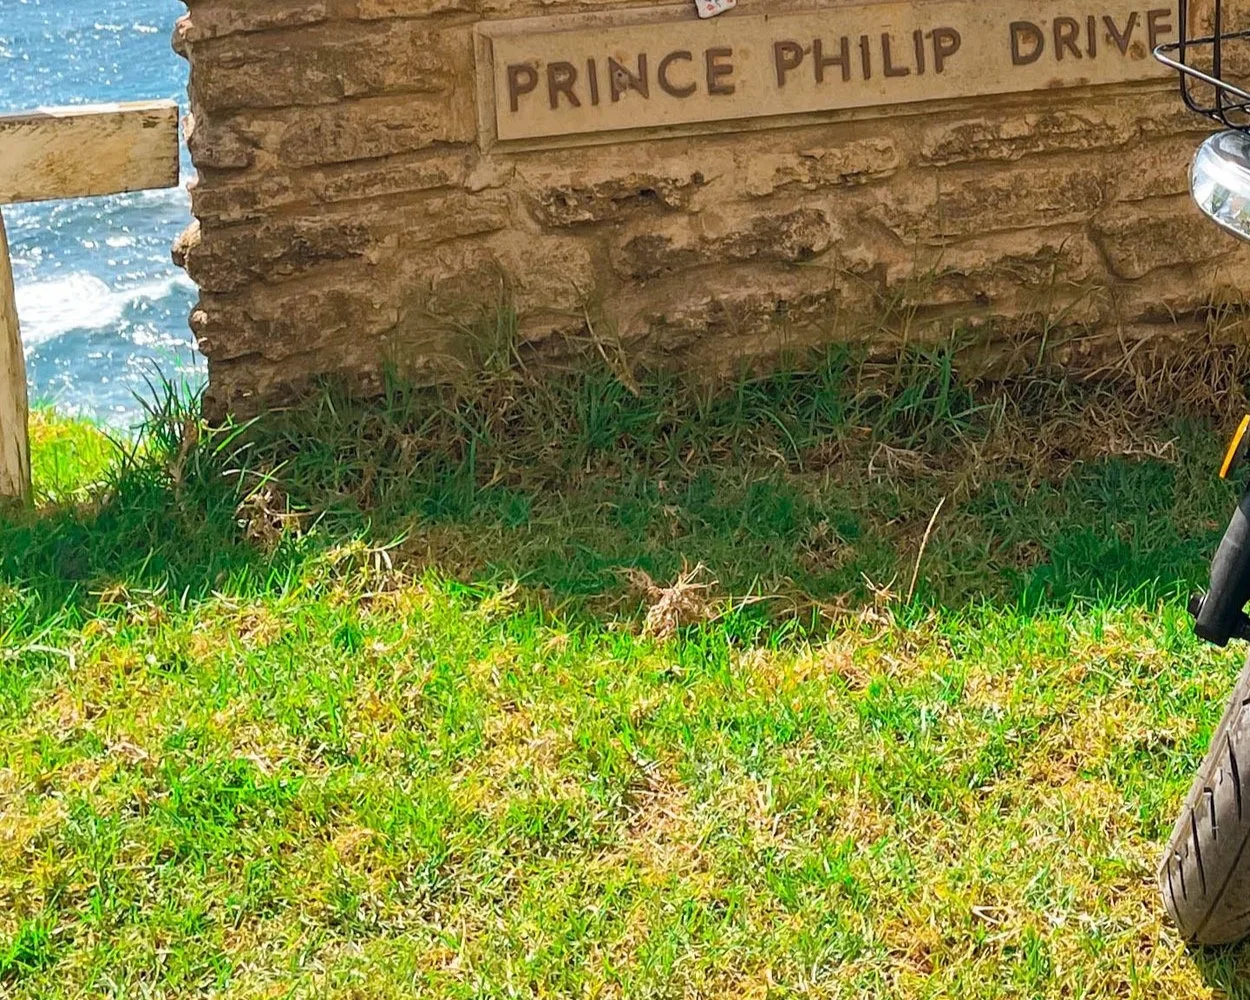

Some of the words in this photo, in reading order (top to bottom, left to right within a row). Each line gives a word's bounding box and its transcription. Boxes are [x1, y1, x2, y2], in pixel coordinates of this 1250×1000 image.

[507, 47, 735, 113] PRINCE
[774, 26, 962, 88] PHILIP
[1010, 8, 1173, 67] DRIVE
